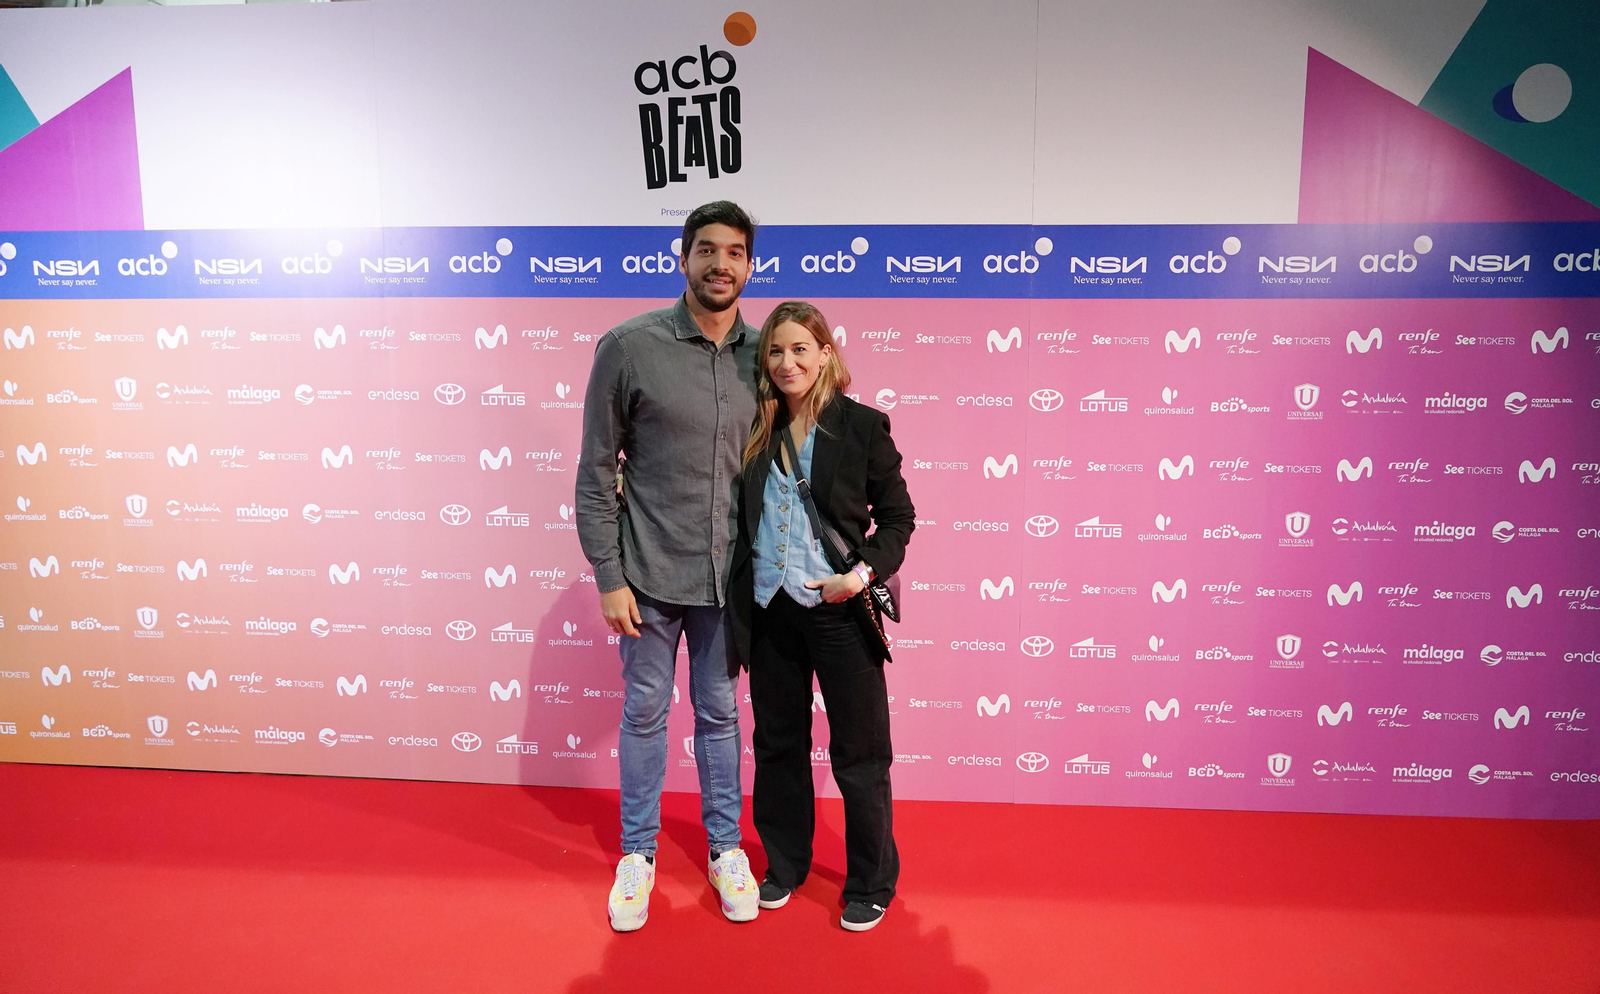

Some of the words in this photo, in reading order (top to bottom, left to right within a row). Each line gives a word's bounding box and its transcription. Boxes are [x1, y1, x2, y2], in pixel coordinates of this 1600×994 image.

[634, 44, 737, 95] acb
[638, 85, 742, 190] BEATS
[661, 208, 694, 216] Presen
[118, 254, 168, 276] acb
[281, 254, 332, 275] acb
[449, 252, 501, 273] acb
[622, 252, 676, 273] acb
[801, 251, 855, 273] acb
[983, 251, 1039, 273] acb
[1169, 251, 1226, 273] acb
[1360, 250, 1417, 273] acb
[751, 276, 776, 284] never.
[890, 275, 914, 283] Never
[47, 327, 81, 341] renfe
[201, 326, 236, 341] renfe
[359, 326, 395, 340] renfe
[522, 326, 558, 341] renfe
[862, 327, 900, 342] renfe
[1037, 329, 1076, 344] renfe
[1217, 329, 1257, 344] renfe
[1398, 329, 1439, 344] renfe
[368, 388, 419, 400] endesa
[481, 395, 525, 405] LOTUS
[956, 394, 1012, 406] endesa
[1080, 401, 1128, 412] LOTUS
[59, 444, 93, 458] renfe
[210, 445, 245, 459] renfe
[366, 447, 401, 461] renfe
[526, 449, 562, 462] renfe
[1033, 456, 1072, 470] renfe
[1209, 457, 1249, 472] renfe
[1388, 458, 1429, 473] renfe
[375, 509, 425, 520] endesa
[486, 516, 529, 526] LOTUS
[953, 519, 1009, 532] endesa
[1075, 527, 1122, 538] LOTUS
[71, 558, 105, 572] renfe
[220, 561, 253, 574] renfe
[373, 564, 407, 578] renfe
[530, 567, 565, 581] renfe
[1029, 579, 1067, 593] renfe
[1202, 581, 1241, 595] renfe
[1378, 583, 1418, 598] renfe
[1559, 586, 1599, 600] renfe
[382, 624, 431, 635] endesa
[491, 632, 534, 642] LOTUS
[951, 639, 1005, 651] endesa
[1070, 648, 1116, 658] LOTUS
[83, 667, 115, 680] renfe
[229, 672, 262, 686] renfe
[380, 677, 414, 690] renfe
[535, 682, 569, 695] renfe
[1024, 697, 1062, 711] renfe
[1195, 701, 1233, 714] renfe
[1368, 704, 1407, 718] renfe
[1545, 708, 1585, 722] renfe
[388, 735, 437, 746] endesa
[496, 744, 538, 754] LOTUS
[948, 754, 1001, 766] endesa
[1065, 764, 1110, 774] LOTUS
